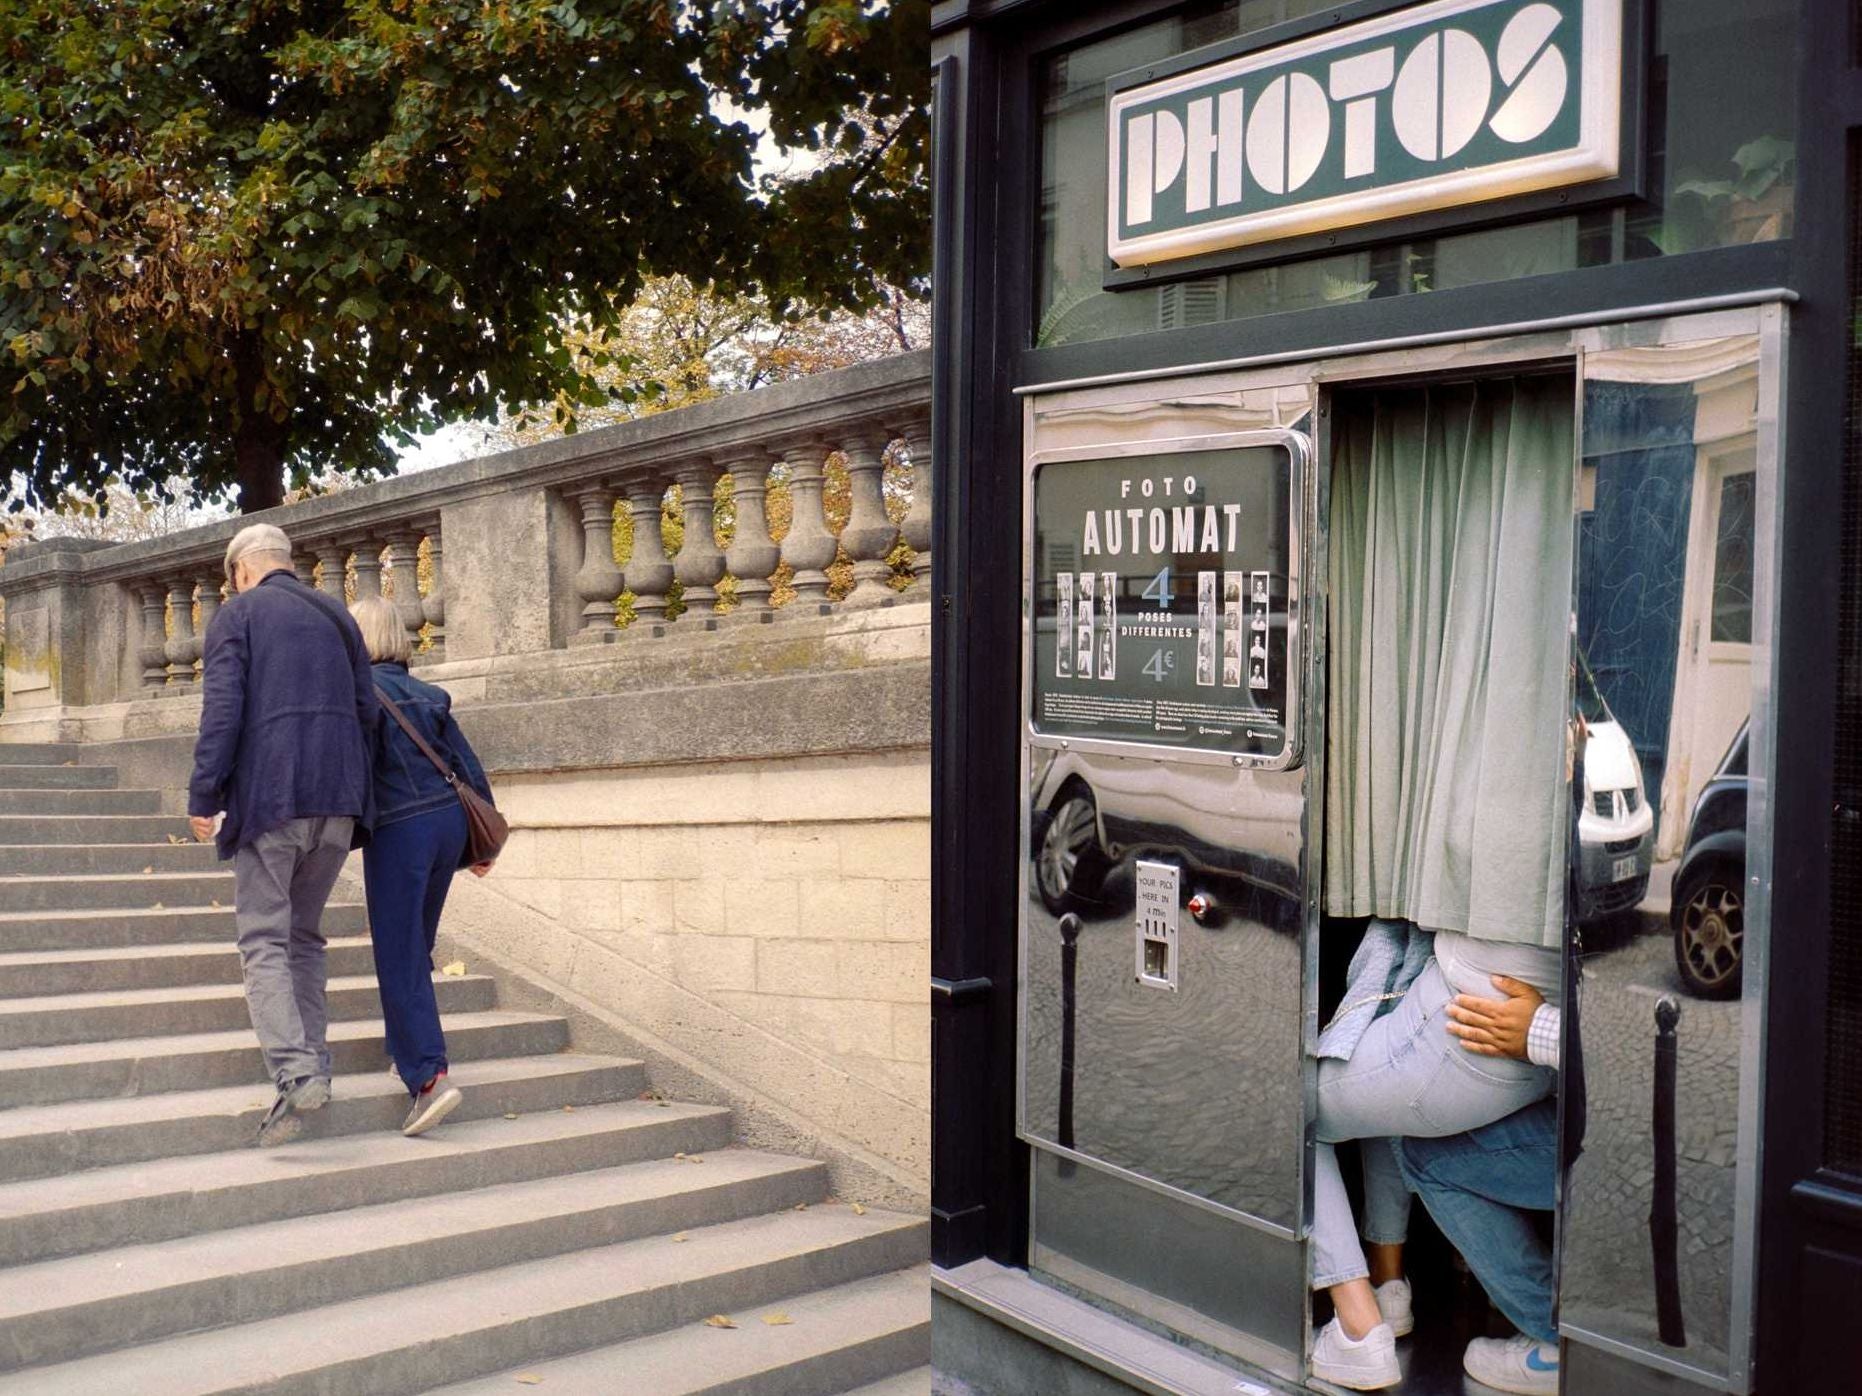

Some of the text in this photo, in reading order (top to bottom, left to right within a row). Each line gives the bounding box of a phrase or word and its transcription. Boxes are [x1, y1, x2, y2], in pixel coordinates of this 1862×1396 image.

[1126, 2, 1568, 227] PHOTOS
[1121, 475, 1196, 498] FOTO
[1083, 503, 1241, 555] AUTOMAT
[1141, 566, 1175, 609] 4
[1137, 612, 1173, 623] POSES
[1121, 625, 1193, 638] DIFFERENTES
[1141, 648, 1175, 682] 4€
[1159, 879, 1173, 890] PICS
[1141, 892, 1169, 903] HERE IN
